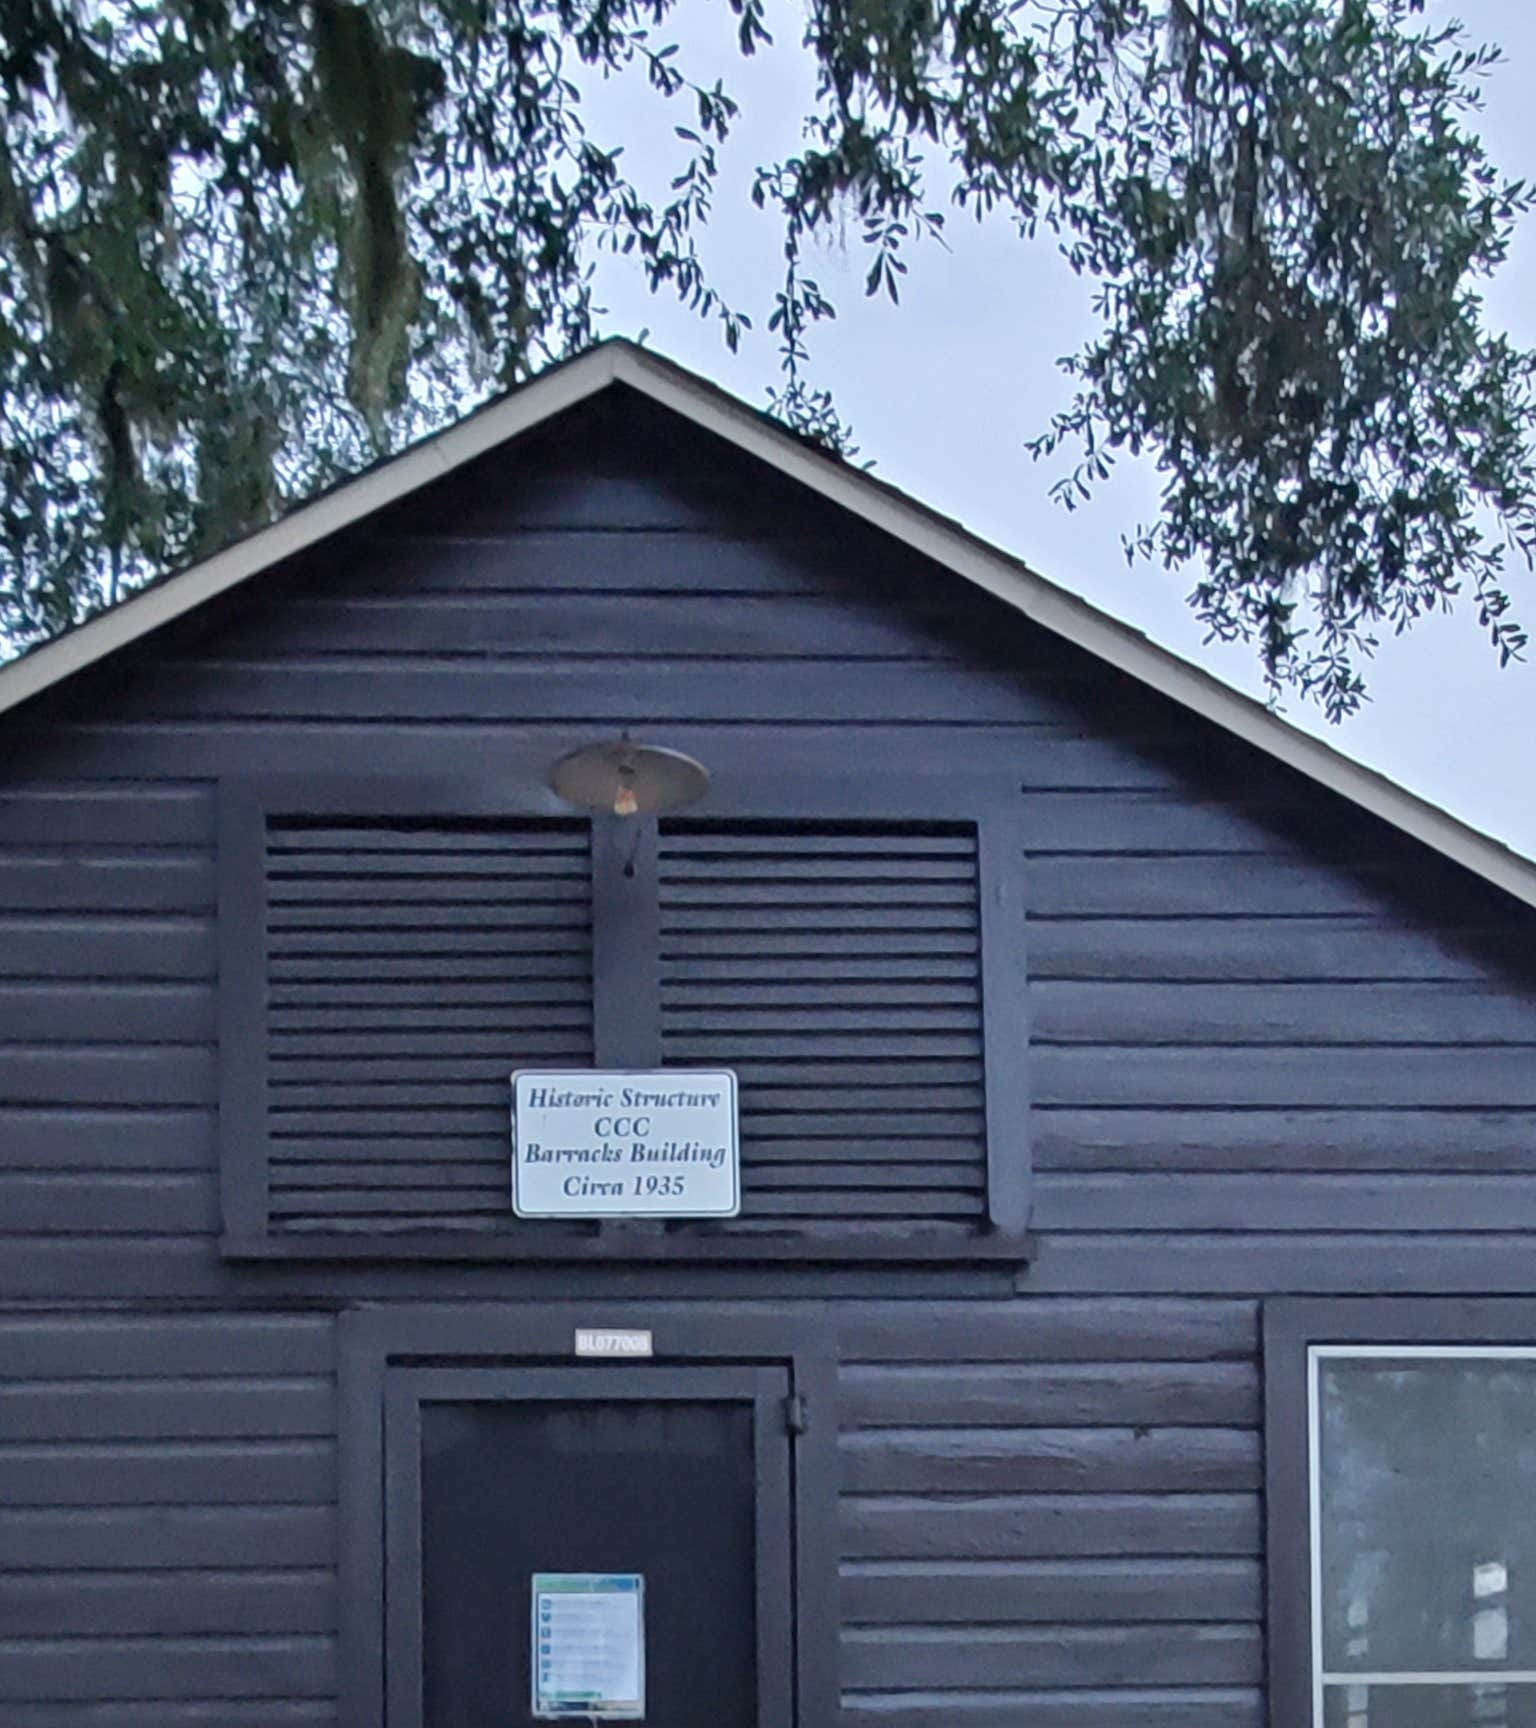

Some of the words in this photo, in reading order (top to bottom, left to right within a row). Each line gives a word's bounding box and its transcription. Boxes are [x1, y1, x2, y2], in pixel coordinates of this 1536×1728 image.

[528, 1088, 613, 1108] Historic
[620, 1087, 721, 1108] Structure
[594, 1117, 651, 1137] CCC
[525, 1143, 623, 1163] Barracks
[630, 1142, 726, 1168] Building
[563, 1176, 624, 1197] Circa
[634, 1176, 685, 1196] 1935
